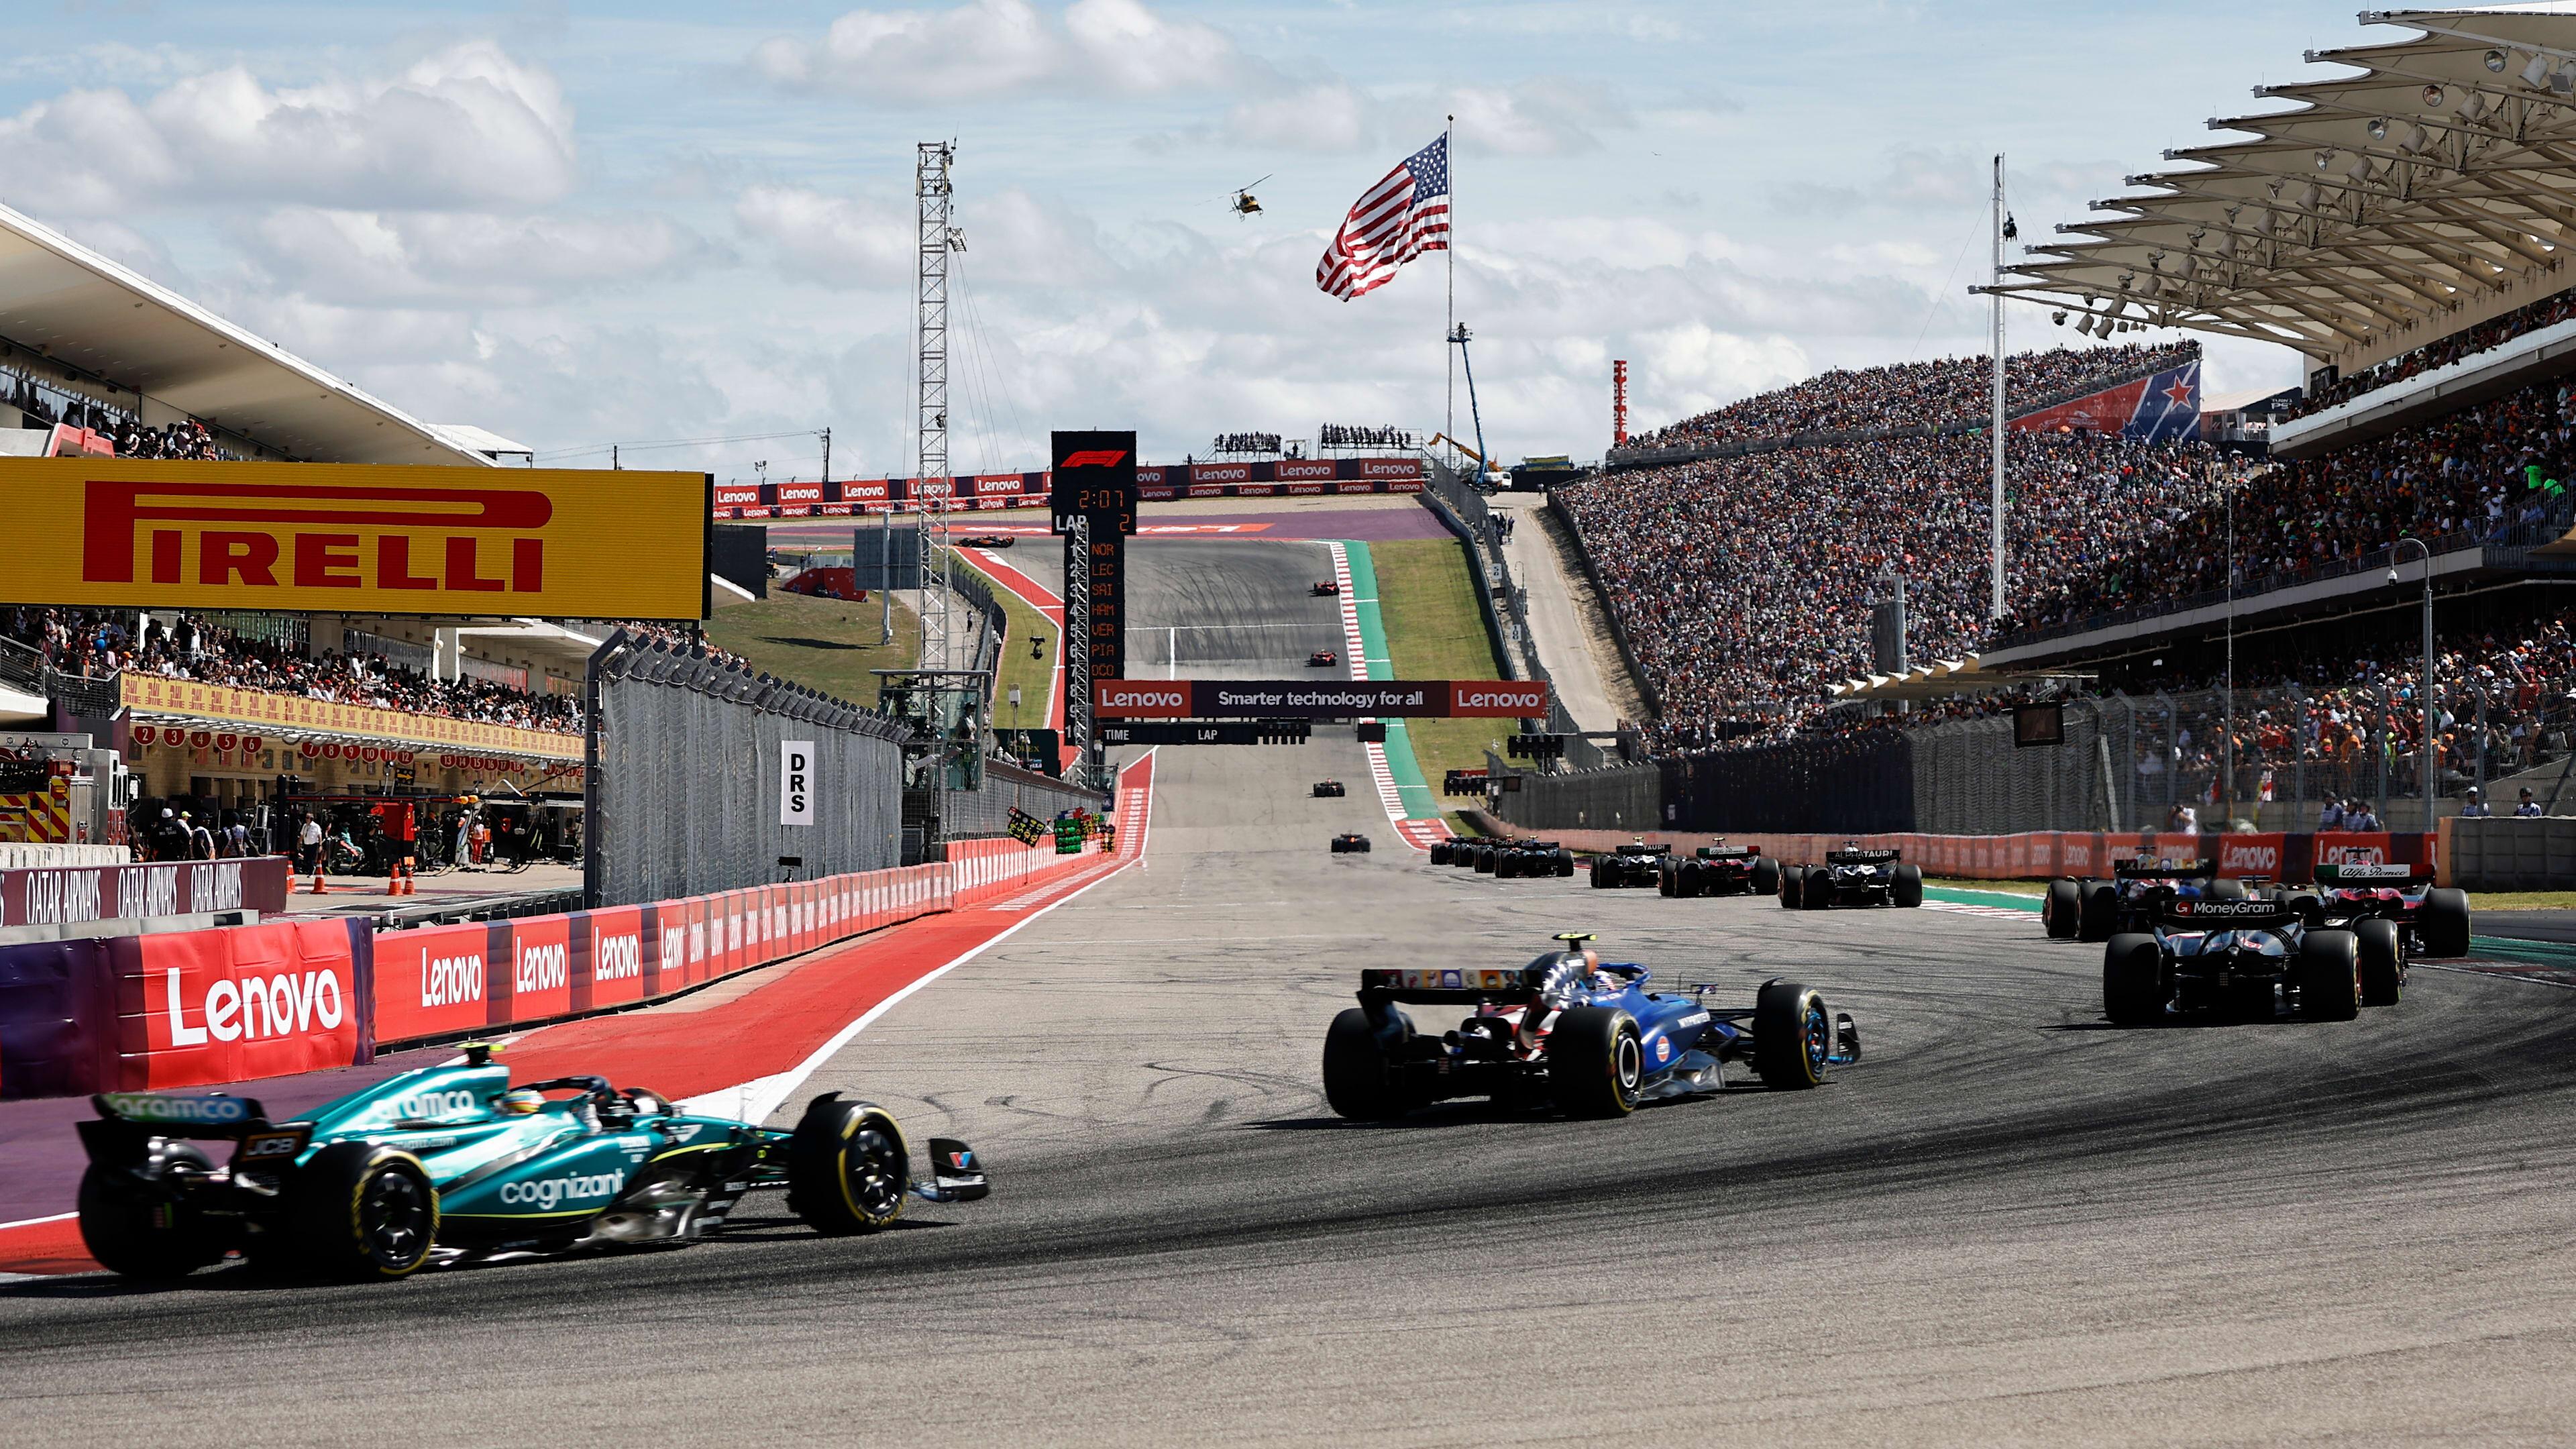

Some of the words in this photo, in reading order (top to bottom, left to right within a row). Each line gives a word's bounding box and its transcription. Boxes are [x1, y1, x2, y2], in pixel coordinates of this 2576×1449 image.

[1060, 450, 1127, 467] F1
[1195, 468, 1246, 480] Lenovo
[1280, 465, 1331, 476] Lenovo
[1364, 462, 1415, 474] Lenovo
[1136, 472, 1161, 482] ovo
[845, 485, 885, 498] Lenovo
[978, 479, 1020, 492] Lenovo
[1289, 485, 1320, 493] Lenovo
[1340, 484, 1371, 492] Lenovo
[718, 490, 757, 503] Lenovo
[780, 487, 820, 500] Lenovo
[1142, 489, 1172, 498] Lenovo
[1190, 488, 1221, 496] Lenovo
[979, 498, 1004, 509] Lenovo
[1079, 490, 1123, 508] 2:07
[743, 508, 769, 517] Lenovo
[783, 506, 808, 515] Lenovo
[1056, 515, 1087, 531] LAP
[1120, 514, 1130, 531] 2
[82, 480, 552, 593] PIRELLI
[1092, 543, 1114, 555] NOR
[1092, 564, 1114, 576] LEC
[1091, 583, 1113, 596] SAI
[1091, 604, 1114, 616] HAM
[1091, 624, 1114, 636] VER
[1091, 644, 1114, 656] PIA
[1091, 664, 1114, 676] OCO
[1102, 689, 1183, 706] Lenovo
[1218, 691, 1283, 706] Smarter
[1287, 692, 1376, 708] technology
[1379, 691, 1403, 706] for
[1405, 691, 1423, 706] all
[1458, 690, 1540, 707] Lenovo
[142, 729, 148, 741] 2
[171, 731, 177, 743] 3
[198, 733, 204, 744] 4
[224, 735, 229, 747] 5
[1104, 729, 1130, 741] TIME
[1197, 729, 1218, 741] LAP
[249, 738, 255, 749] 6
[309, 743, 314, 754] 7
[329, 745, 334, 756] 8
[348, 747, 354, 757] 9
[366, 749, 375, 759] 10
[402, 751, 410, 762] 12
[444, 755, 452, 765] 13
[458, 757, 466, 766] 14
[474, 758, 481, 767] 15
[488, 759, 495, 769] 16
[790, 753, 805, 812] DRS
[1835, 850, 1892, 858] ALPHATAURI
[2222, 841, 2276, 869] Lenovo
[2341, 868, 2369, 878] Alfa
[2369, 867, 2406, 877] Romeo
[146, 866, 177, 916] AIRWAYS
[214, 863, 241, 910] AIRWAYS
[26, 871, 60, 924] QATAR
[63, 869, 101, 922] AIRWAYS
[2194, 902, 2275, 915] MoneyGram
[595, 926, 639, 980] Lenovo
[517, 936, 565, 993] Lenovo
[422, 947, 482, 1007] Lenovo
[167, 967, 342, 1046] Lenovo
[115, 1098, 241, 1118] aramco
[371, 1090, 474, 1118] aramco
[247, 1138, 294, 1156] JCB
[500, 1168, 625, 1210] cognizant
